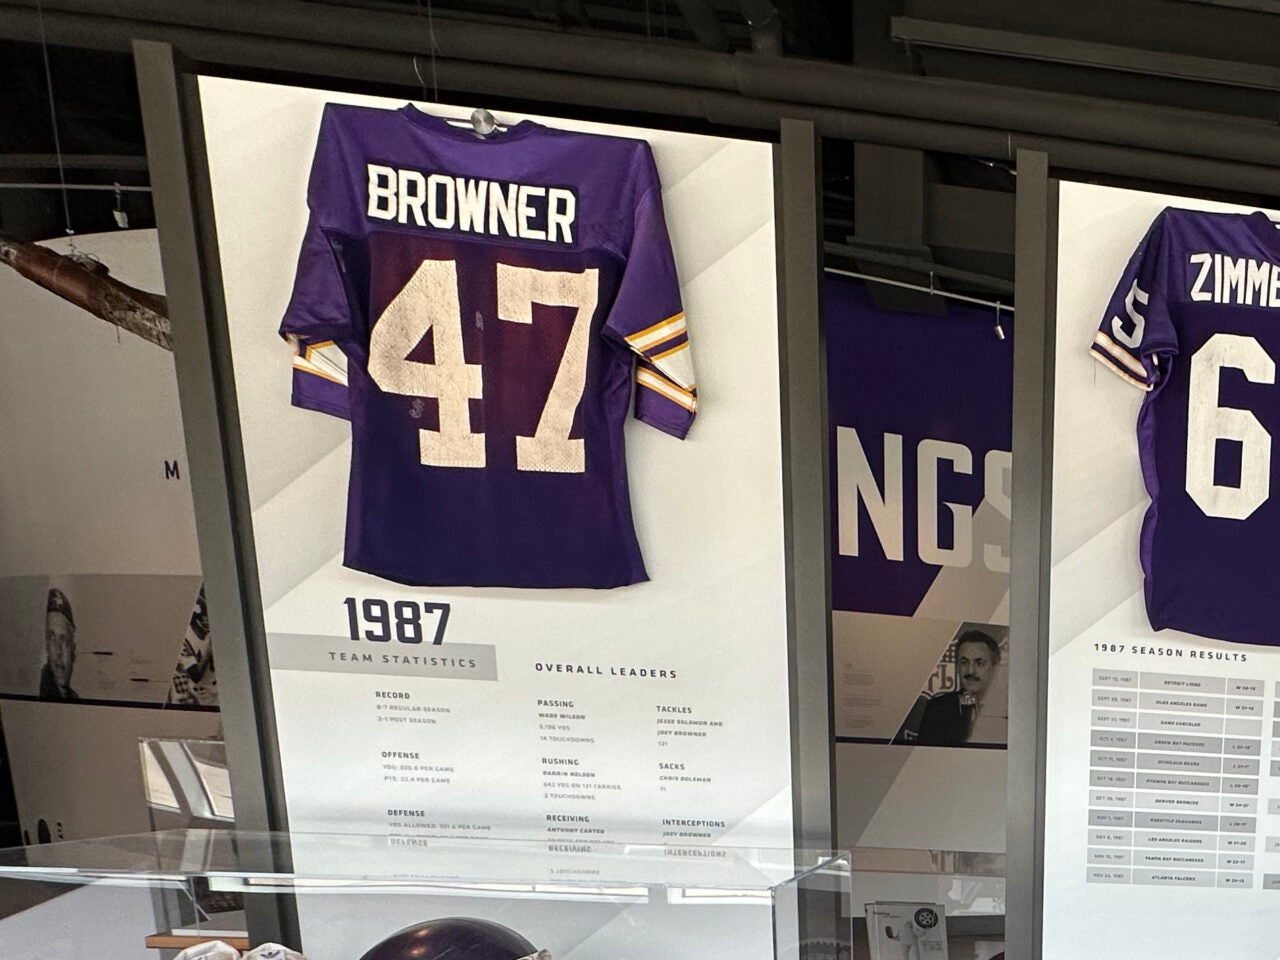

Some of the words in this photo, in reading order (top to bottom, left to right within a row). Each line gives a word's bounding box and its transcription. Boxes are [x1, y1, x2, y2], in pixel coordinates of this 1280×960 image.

[367, 164, 576, 244] BROWNER
[1112, 279, 1149, 348] 5
[367, 258, 599, 474] 47
[344, 597, 450, 645] 1987
[1094, 643, 1125, 653] 1987
[1132, 646, 1183, 657] SEASON
[1190, 650, 1248, 662] RESULTS
[328, 651, 373, 662] TEAM
[382, 654, 477, 668] STATISTICS
[535, 662, 603, 675] OVERALL
[611, 666, 677, 678] LEADERS
[375, 691, 411, 700] RECORD
[537, 699, 575, 708] PASSING
[656, 705, 693, 714] TACKLES
[381, 751, 420, 760] OFFENSE
[541, 757, 580, 766] RUSHING
[658, 762, 686, 771] SACKS
[387, 809, 426, 818] DEFENSE
[546, 814, 590, 823] RECEIVING
[662, 818, 726, 828] INTERCEPTIONS
